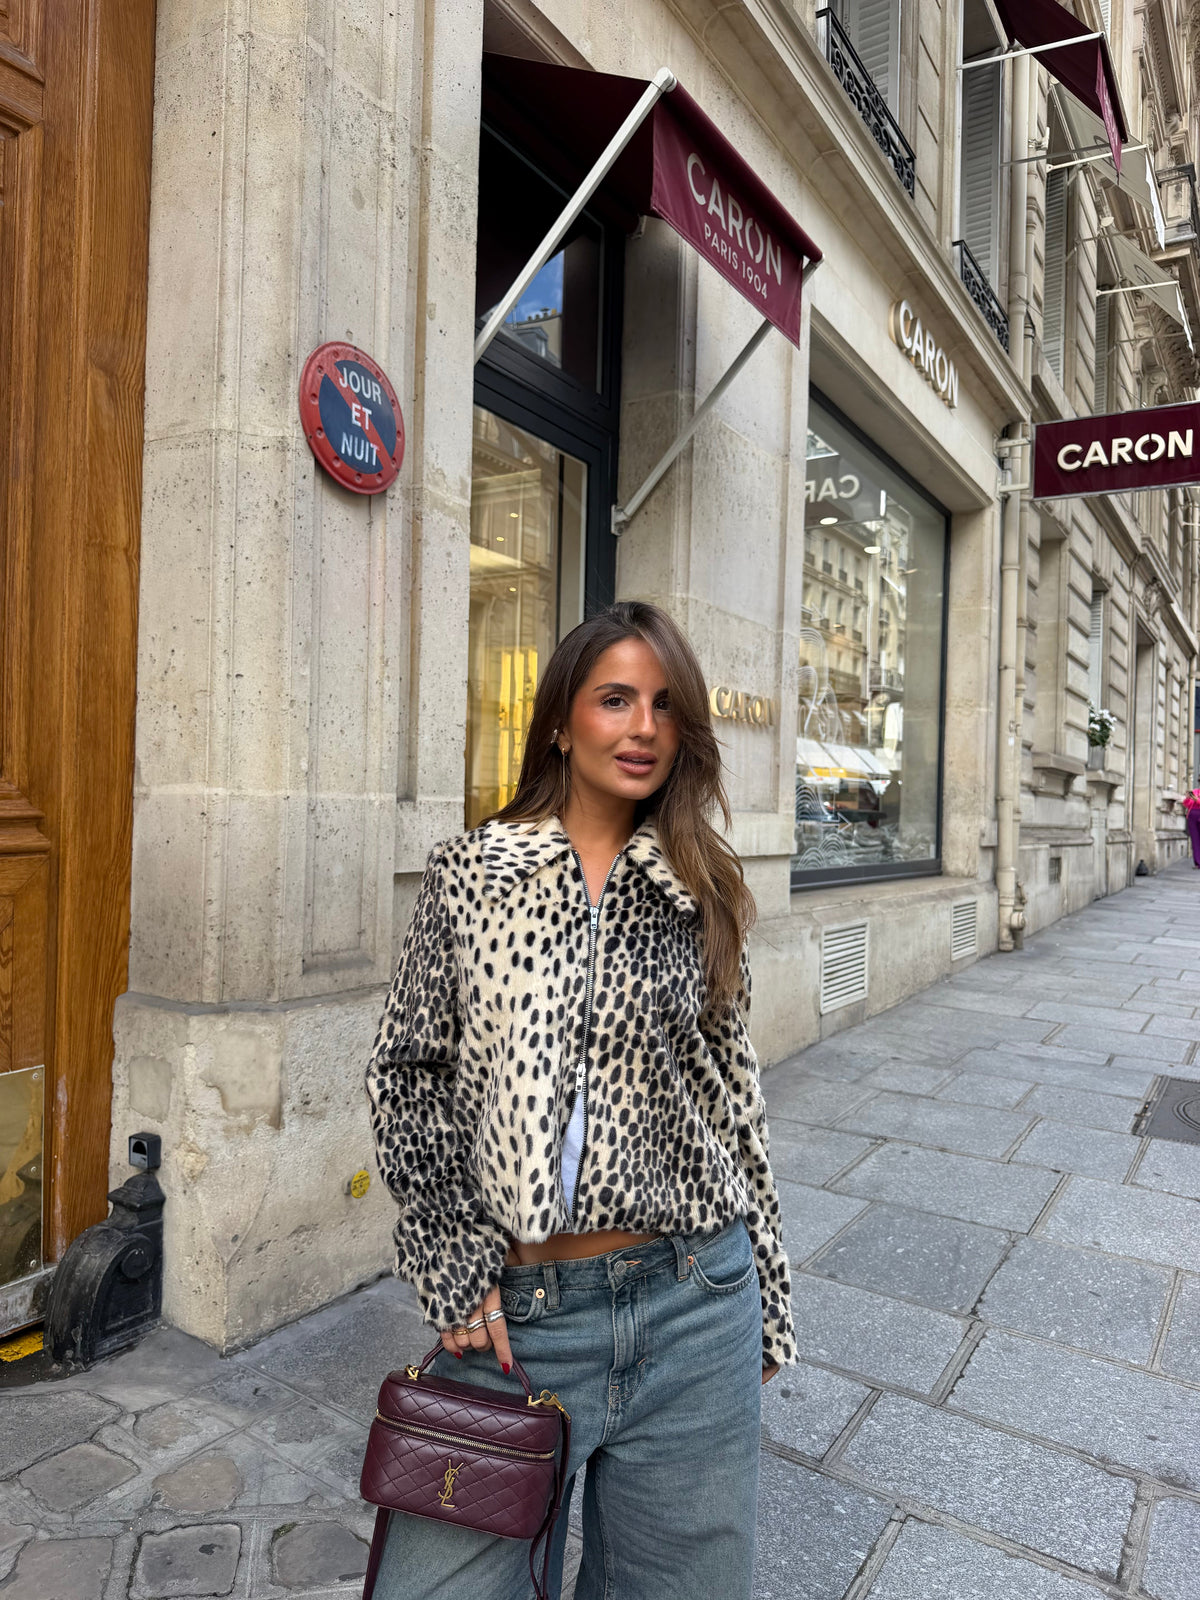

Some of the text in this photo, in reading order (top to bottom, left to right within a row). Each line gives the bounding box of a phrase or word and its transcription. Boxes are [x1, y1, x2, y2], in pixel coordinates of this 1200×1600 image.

[687, 152, 782, 286] CARON
[704, 222, 768, 299] PARIS 1904
[897, 299, 959, 408] CARON
[339, 367, 382, 405] JOUR
[351, 402, 372, 430] ET
[341, 432, 380, 466] NUIT
[1057, 428, 1194, 471] CARON
[710, 686, 774, 726] CARON
